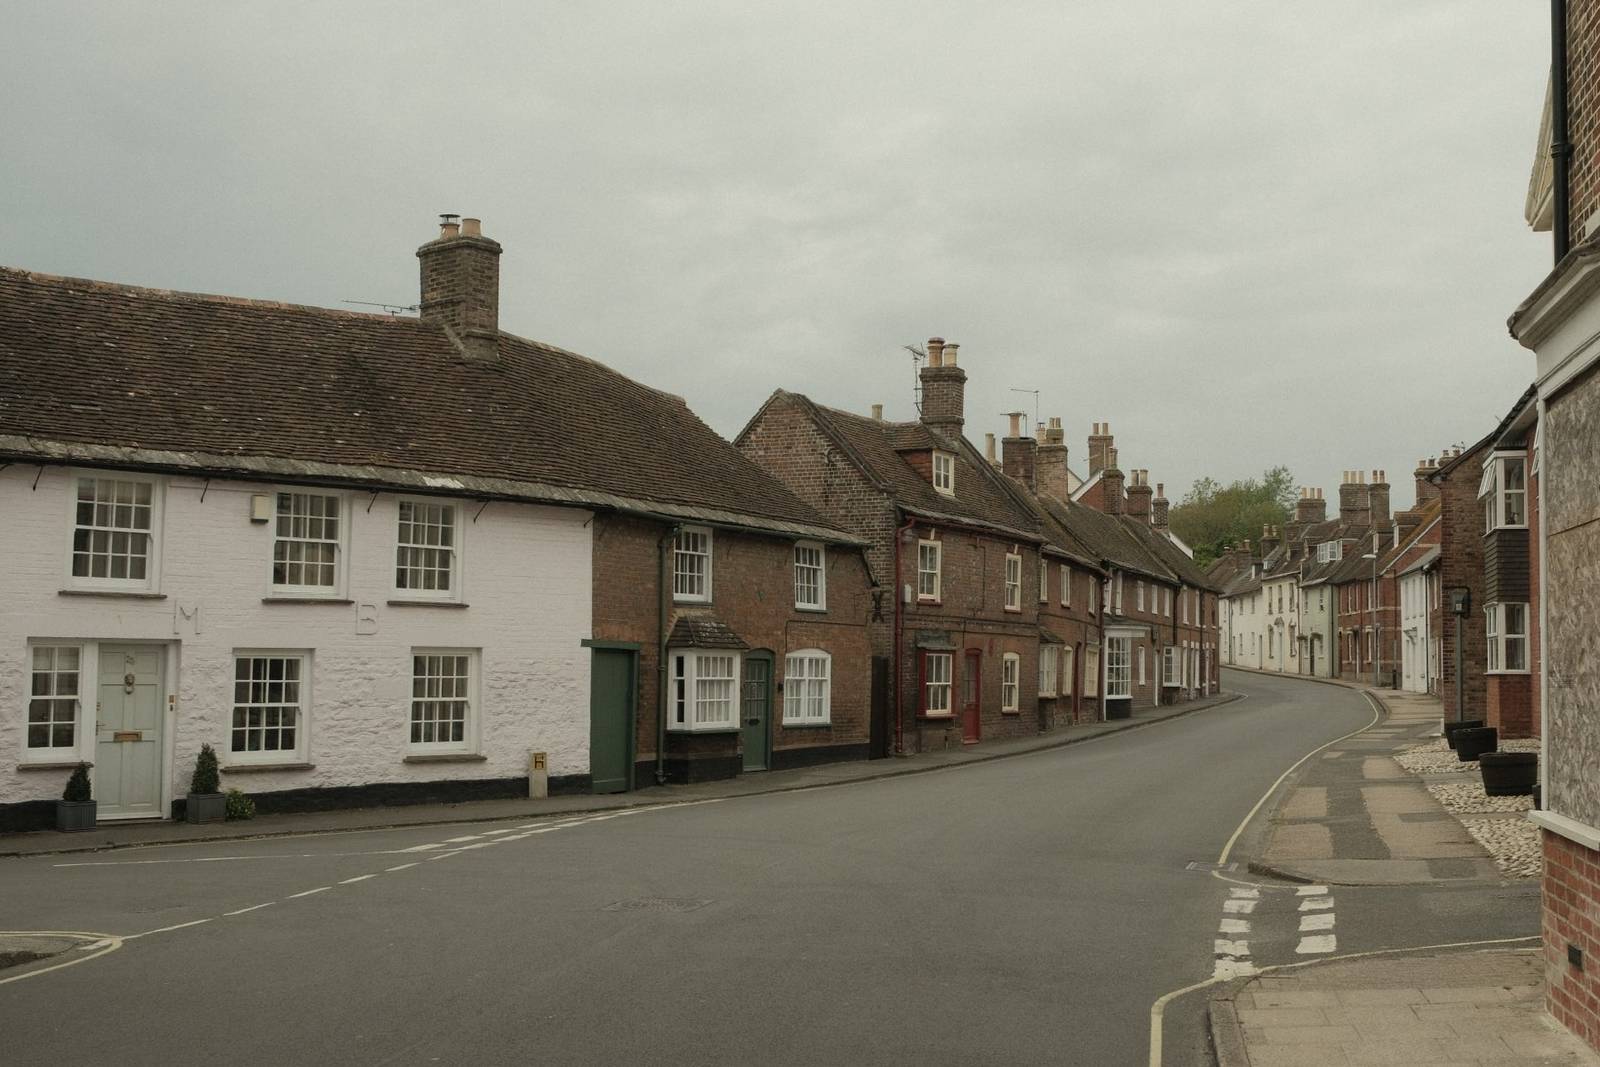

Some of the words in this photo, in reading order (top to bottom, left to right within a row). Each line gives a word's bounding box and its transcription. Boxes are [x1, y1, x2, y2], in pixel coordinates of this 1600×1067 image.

[172, 600, 200, 634] M
[354, 602, 380, 636] B
[535, 755, 545, 768] H
